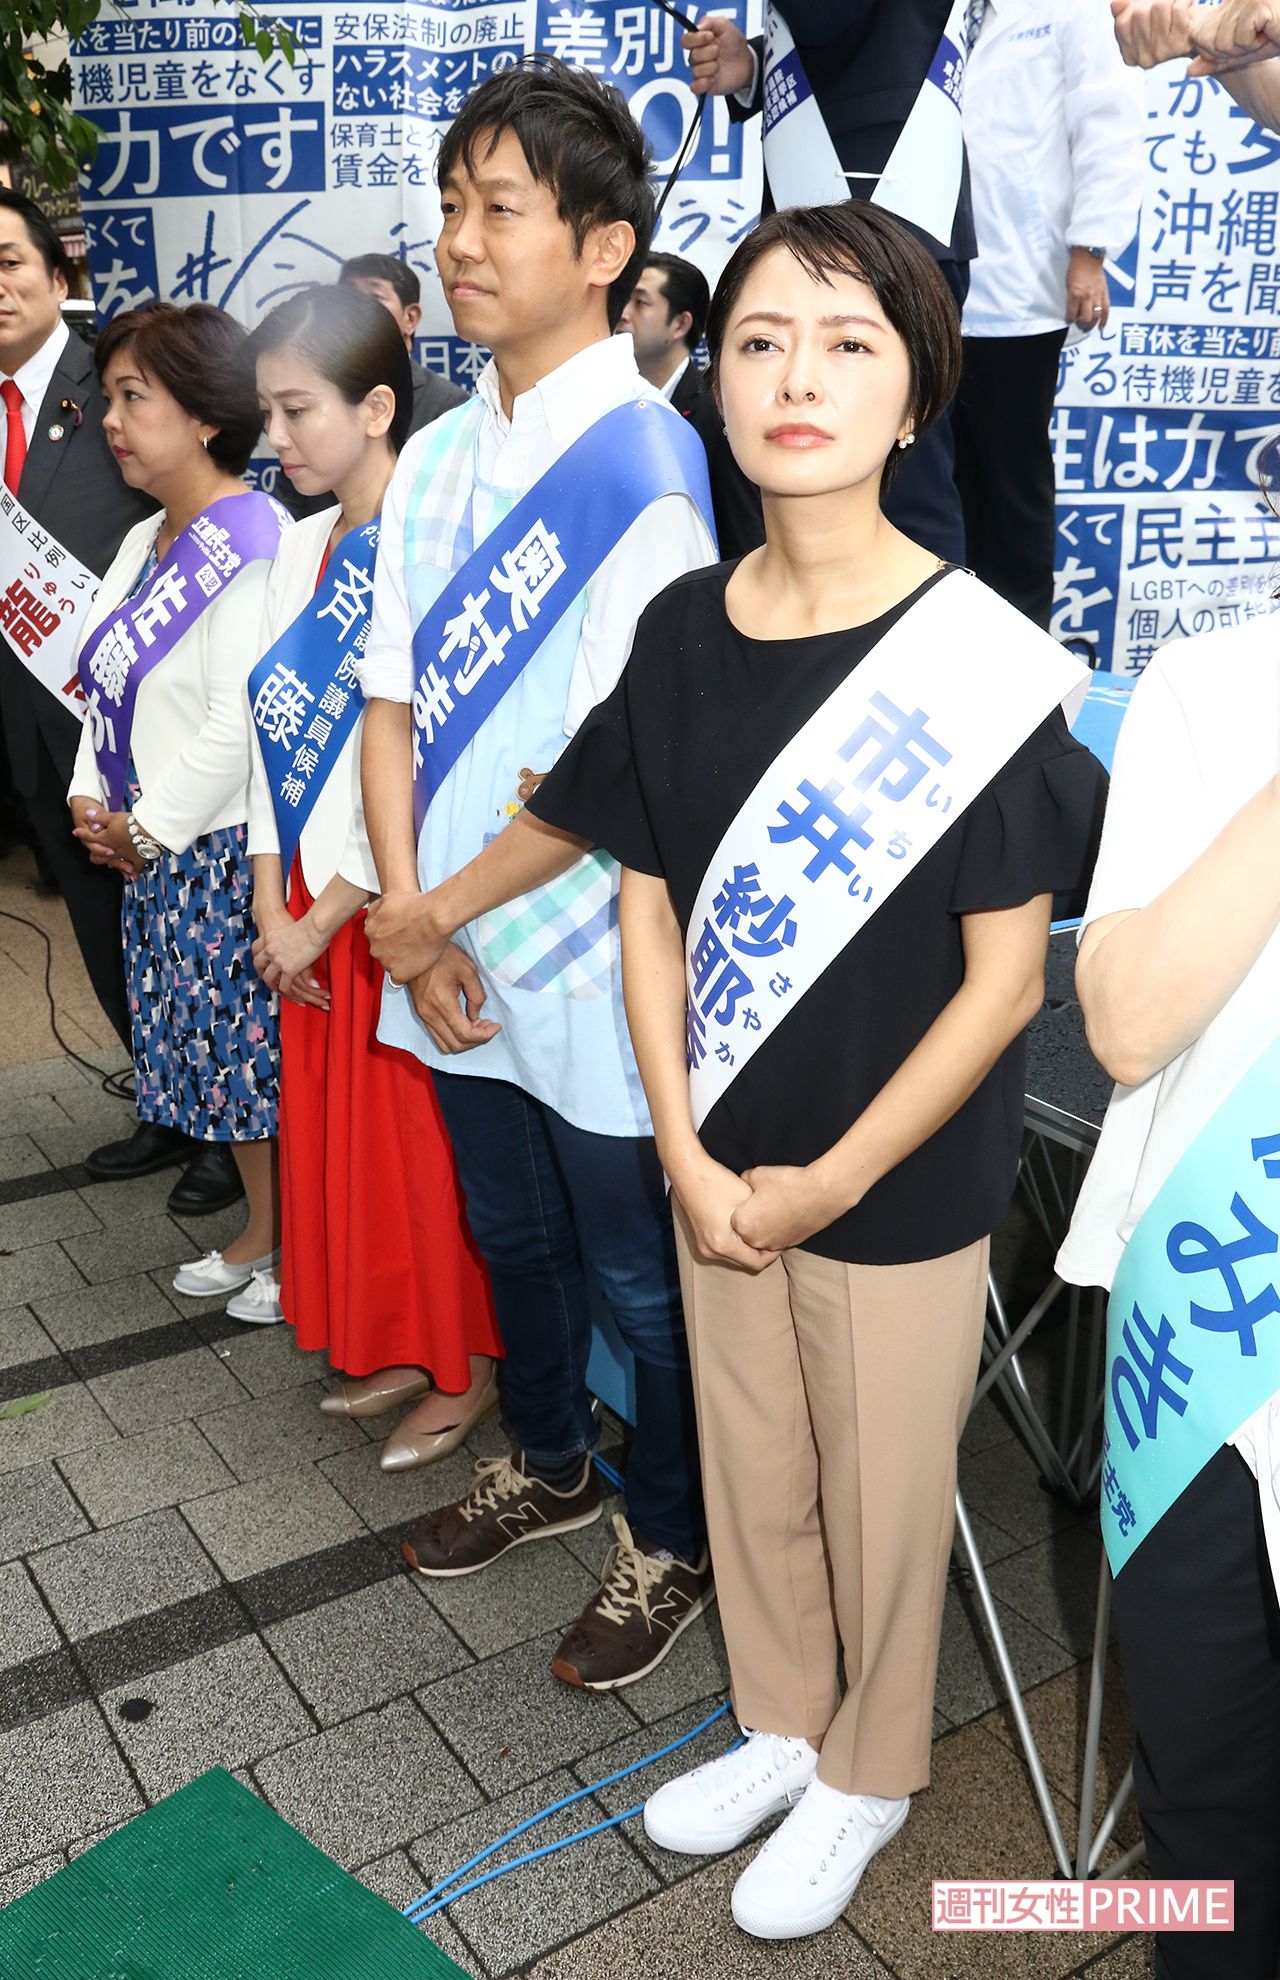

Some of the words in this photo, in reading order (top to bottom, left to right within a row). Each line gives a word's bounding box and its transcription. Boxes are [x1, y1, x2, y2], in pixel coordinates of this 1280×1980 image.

[334, 12, 525, 48] 安保法制の廃止
[70, 58, 326, 104] 機児童をなくす
[334, 49, 519, 83] ハラスメントの
[335, 80, 482, 116] ない社会を
[79, 106, 320, 197] 力です
[332, 152, 430, 189] 賃金を
[1152, 187, 1279, 257] 沖縄
[0, 485, 66, 568] 国区比例
[1058, 510, 1117, 546] くて
[0, 578, 61, 657] 龍
[24, 562, 75, 614] りゅう
[88, 562, 188, 798] 佐藤か
[847, 783, 953, 903] いちい
[714, 971, 793, 1067] さやか
[1110, 1132, 1280, 1453] みき
